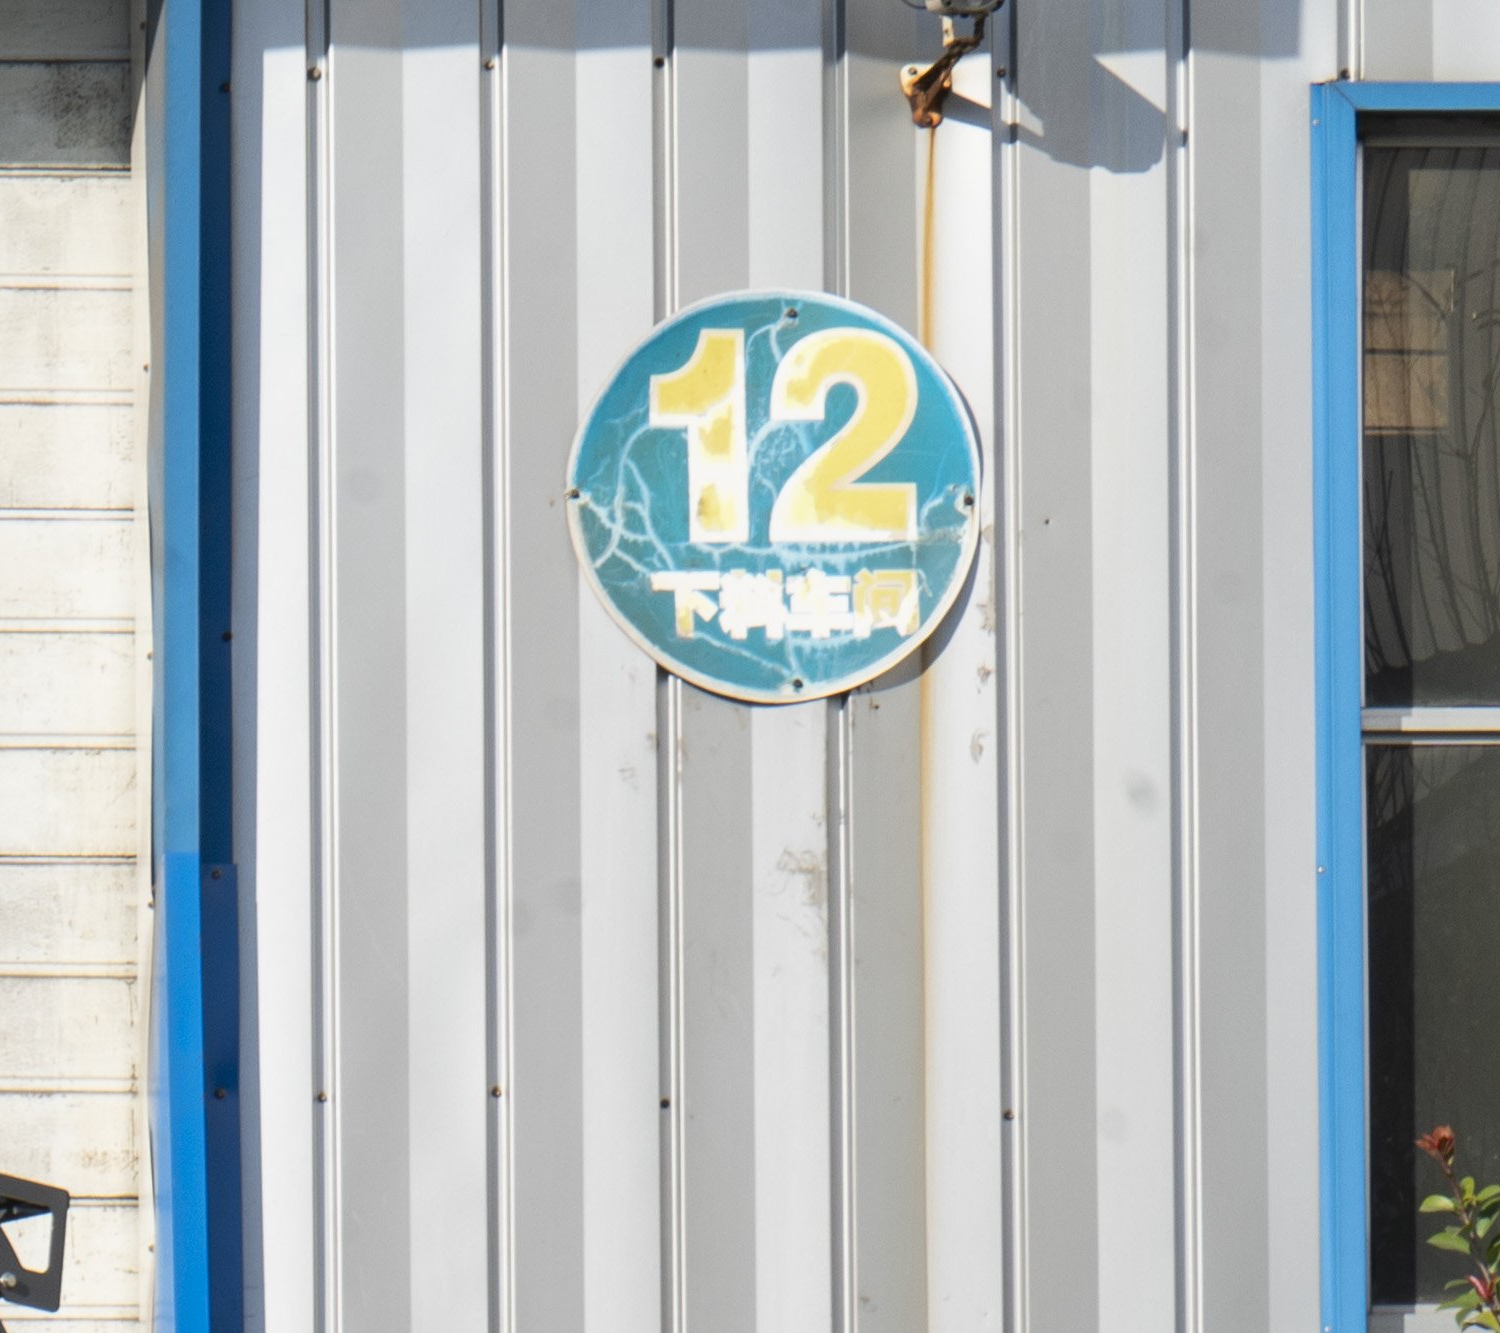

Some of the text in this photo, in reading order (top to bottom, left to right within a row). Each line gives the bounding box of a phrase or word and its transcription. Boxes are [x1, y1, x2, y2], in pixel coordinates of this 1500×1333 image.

[648, 326, 918, 543] 12
[650, 567, 921, 640] 下料车间
